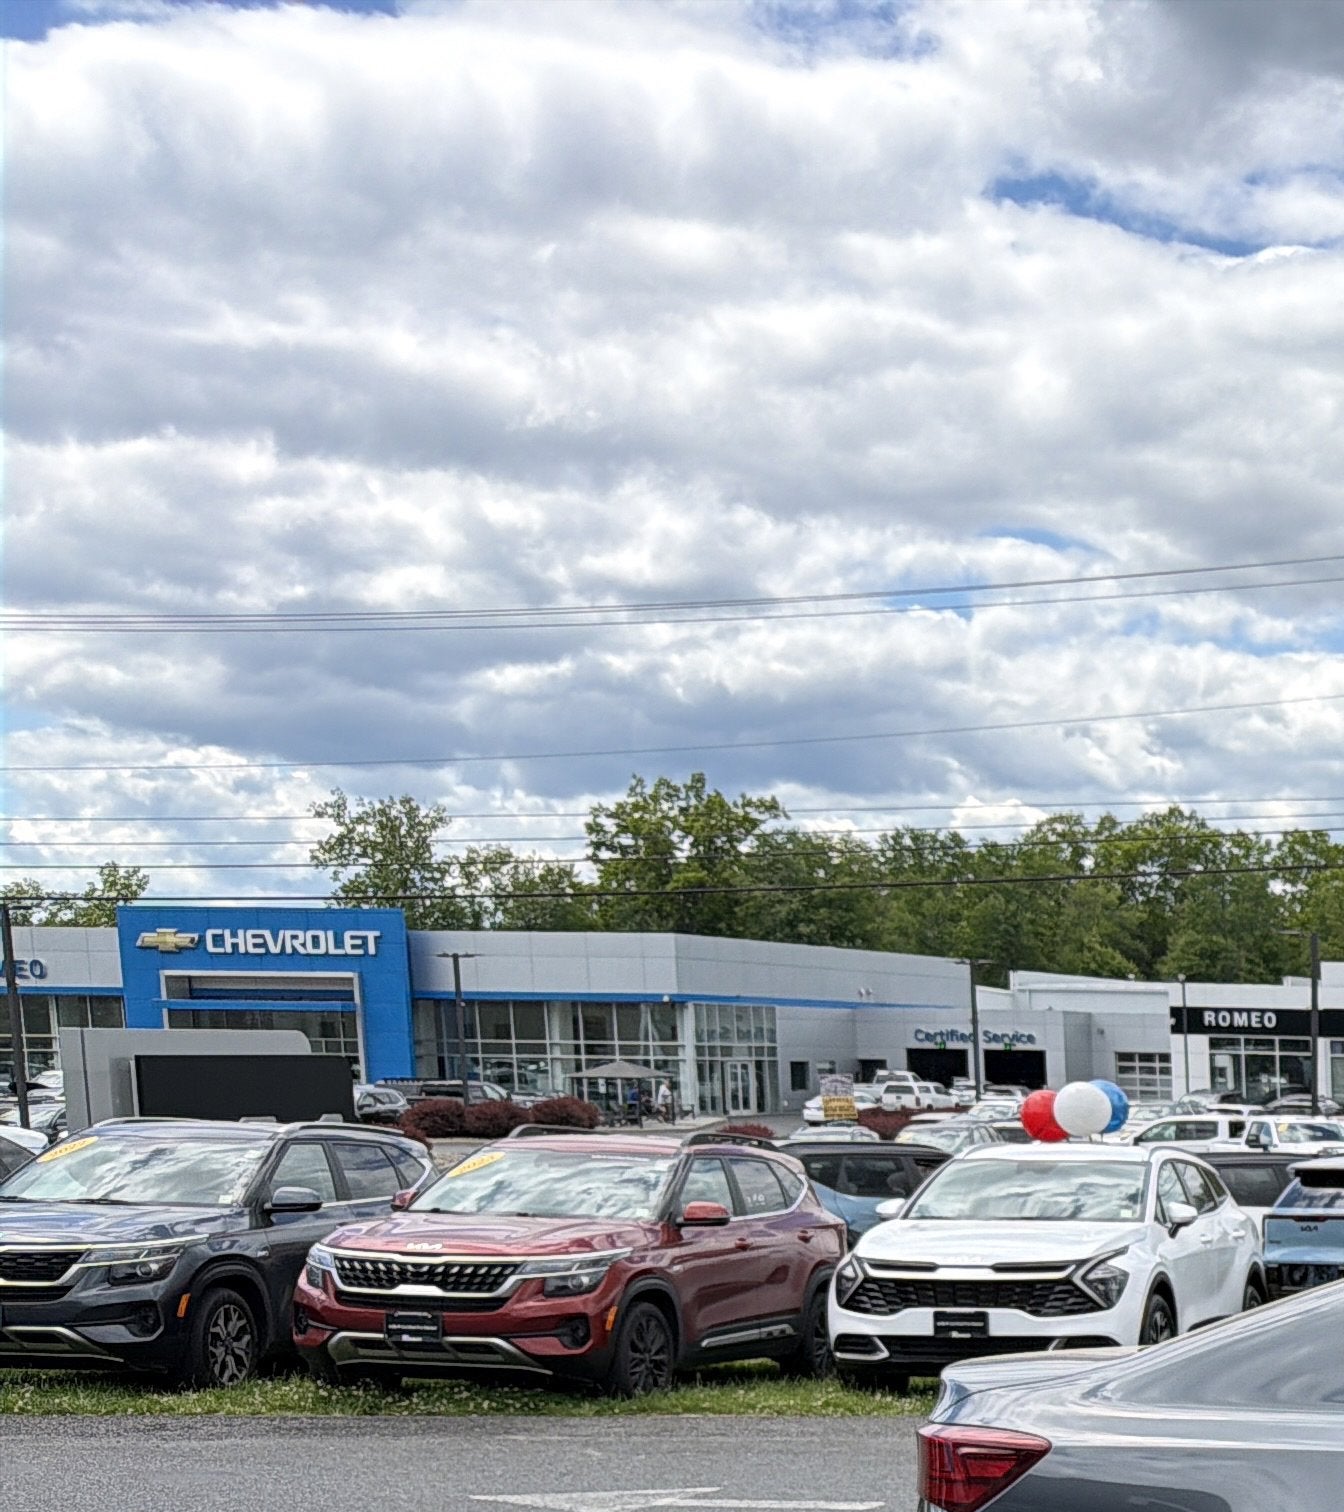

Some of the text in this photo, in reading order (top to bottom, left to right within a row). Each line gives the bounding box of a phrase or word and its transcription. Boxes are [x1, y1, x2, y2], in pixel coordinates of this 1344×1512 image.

[205, 928, 381, 956] CHEVROLET
[0, 959, 47, 980] EO
[1203, 1010, 1277, 1029] ROMEO
[982, 1029, 1036, 1045] Service
